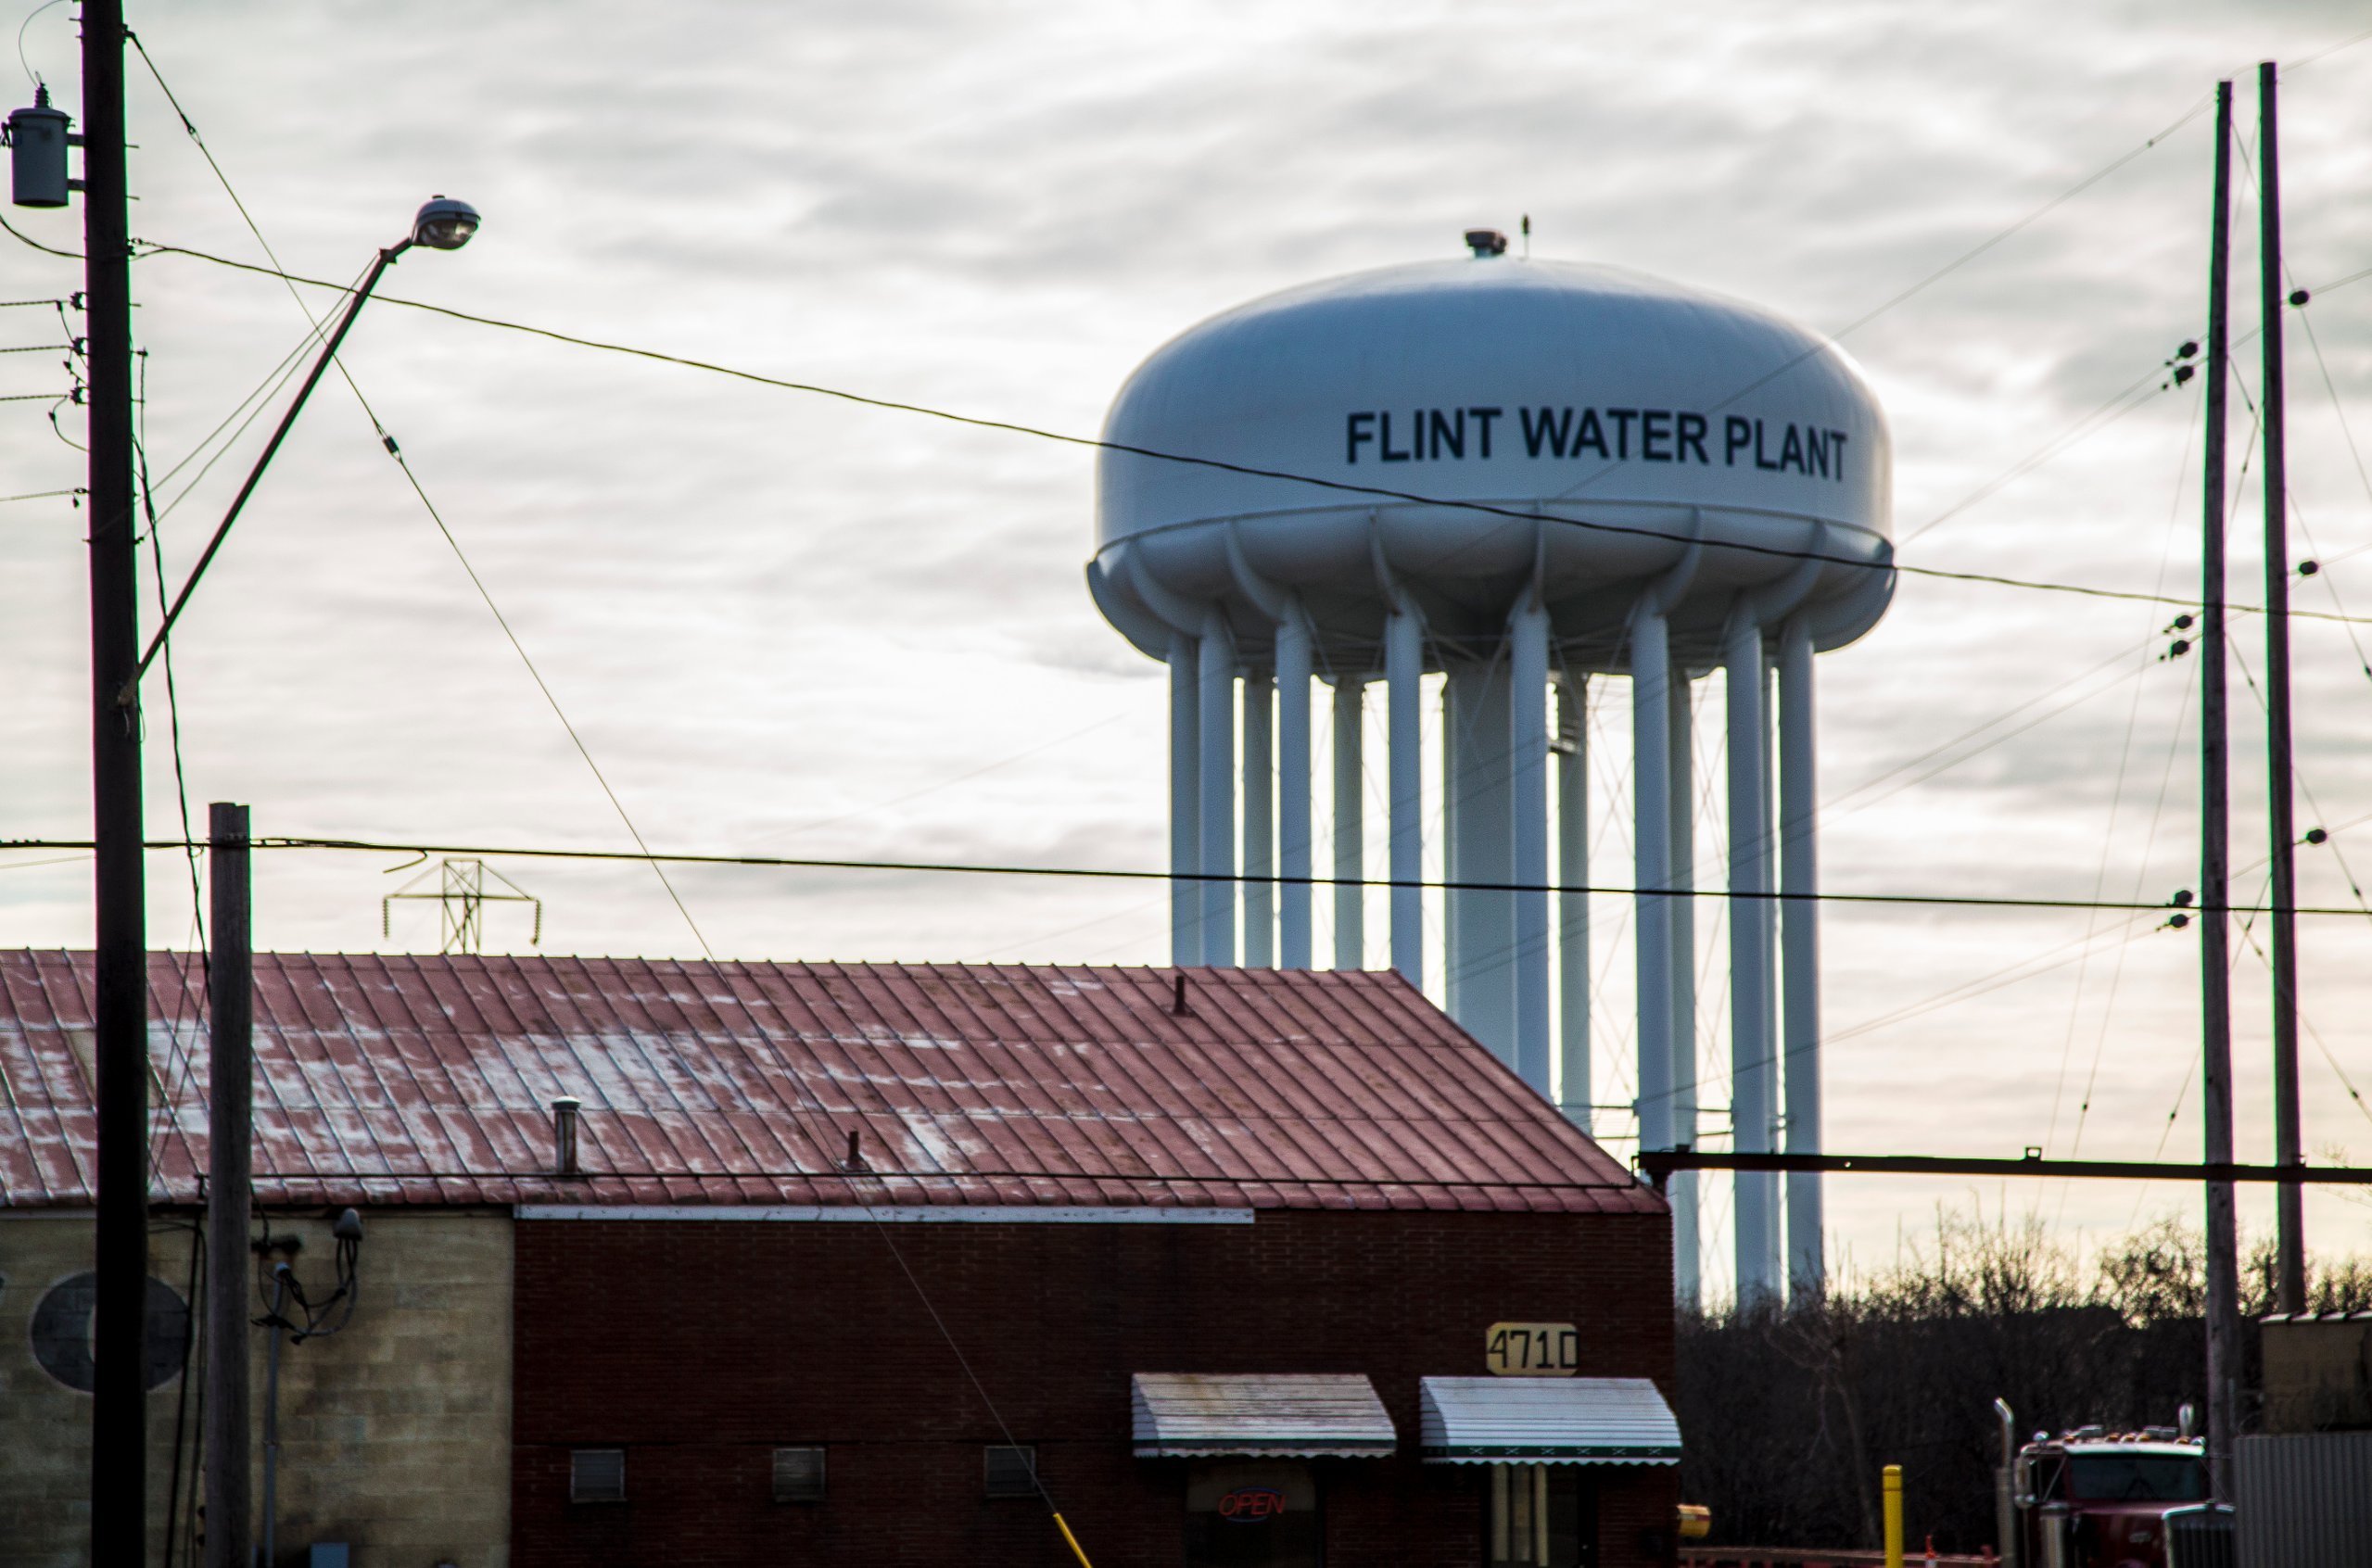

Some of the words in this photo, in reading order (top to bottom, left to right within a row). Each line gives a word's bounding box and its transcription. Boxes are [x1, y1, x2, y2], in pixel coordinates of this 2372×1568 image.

[1347, 407, 1503, 464] FLINT
[1517, 406, 1710, 464] WATER
[1724, 414, 1848, 481] PLANT
[1488, 1330, 1580, 1369] 4710
[1217, 1492, 1287, 1516] OPEN
